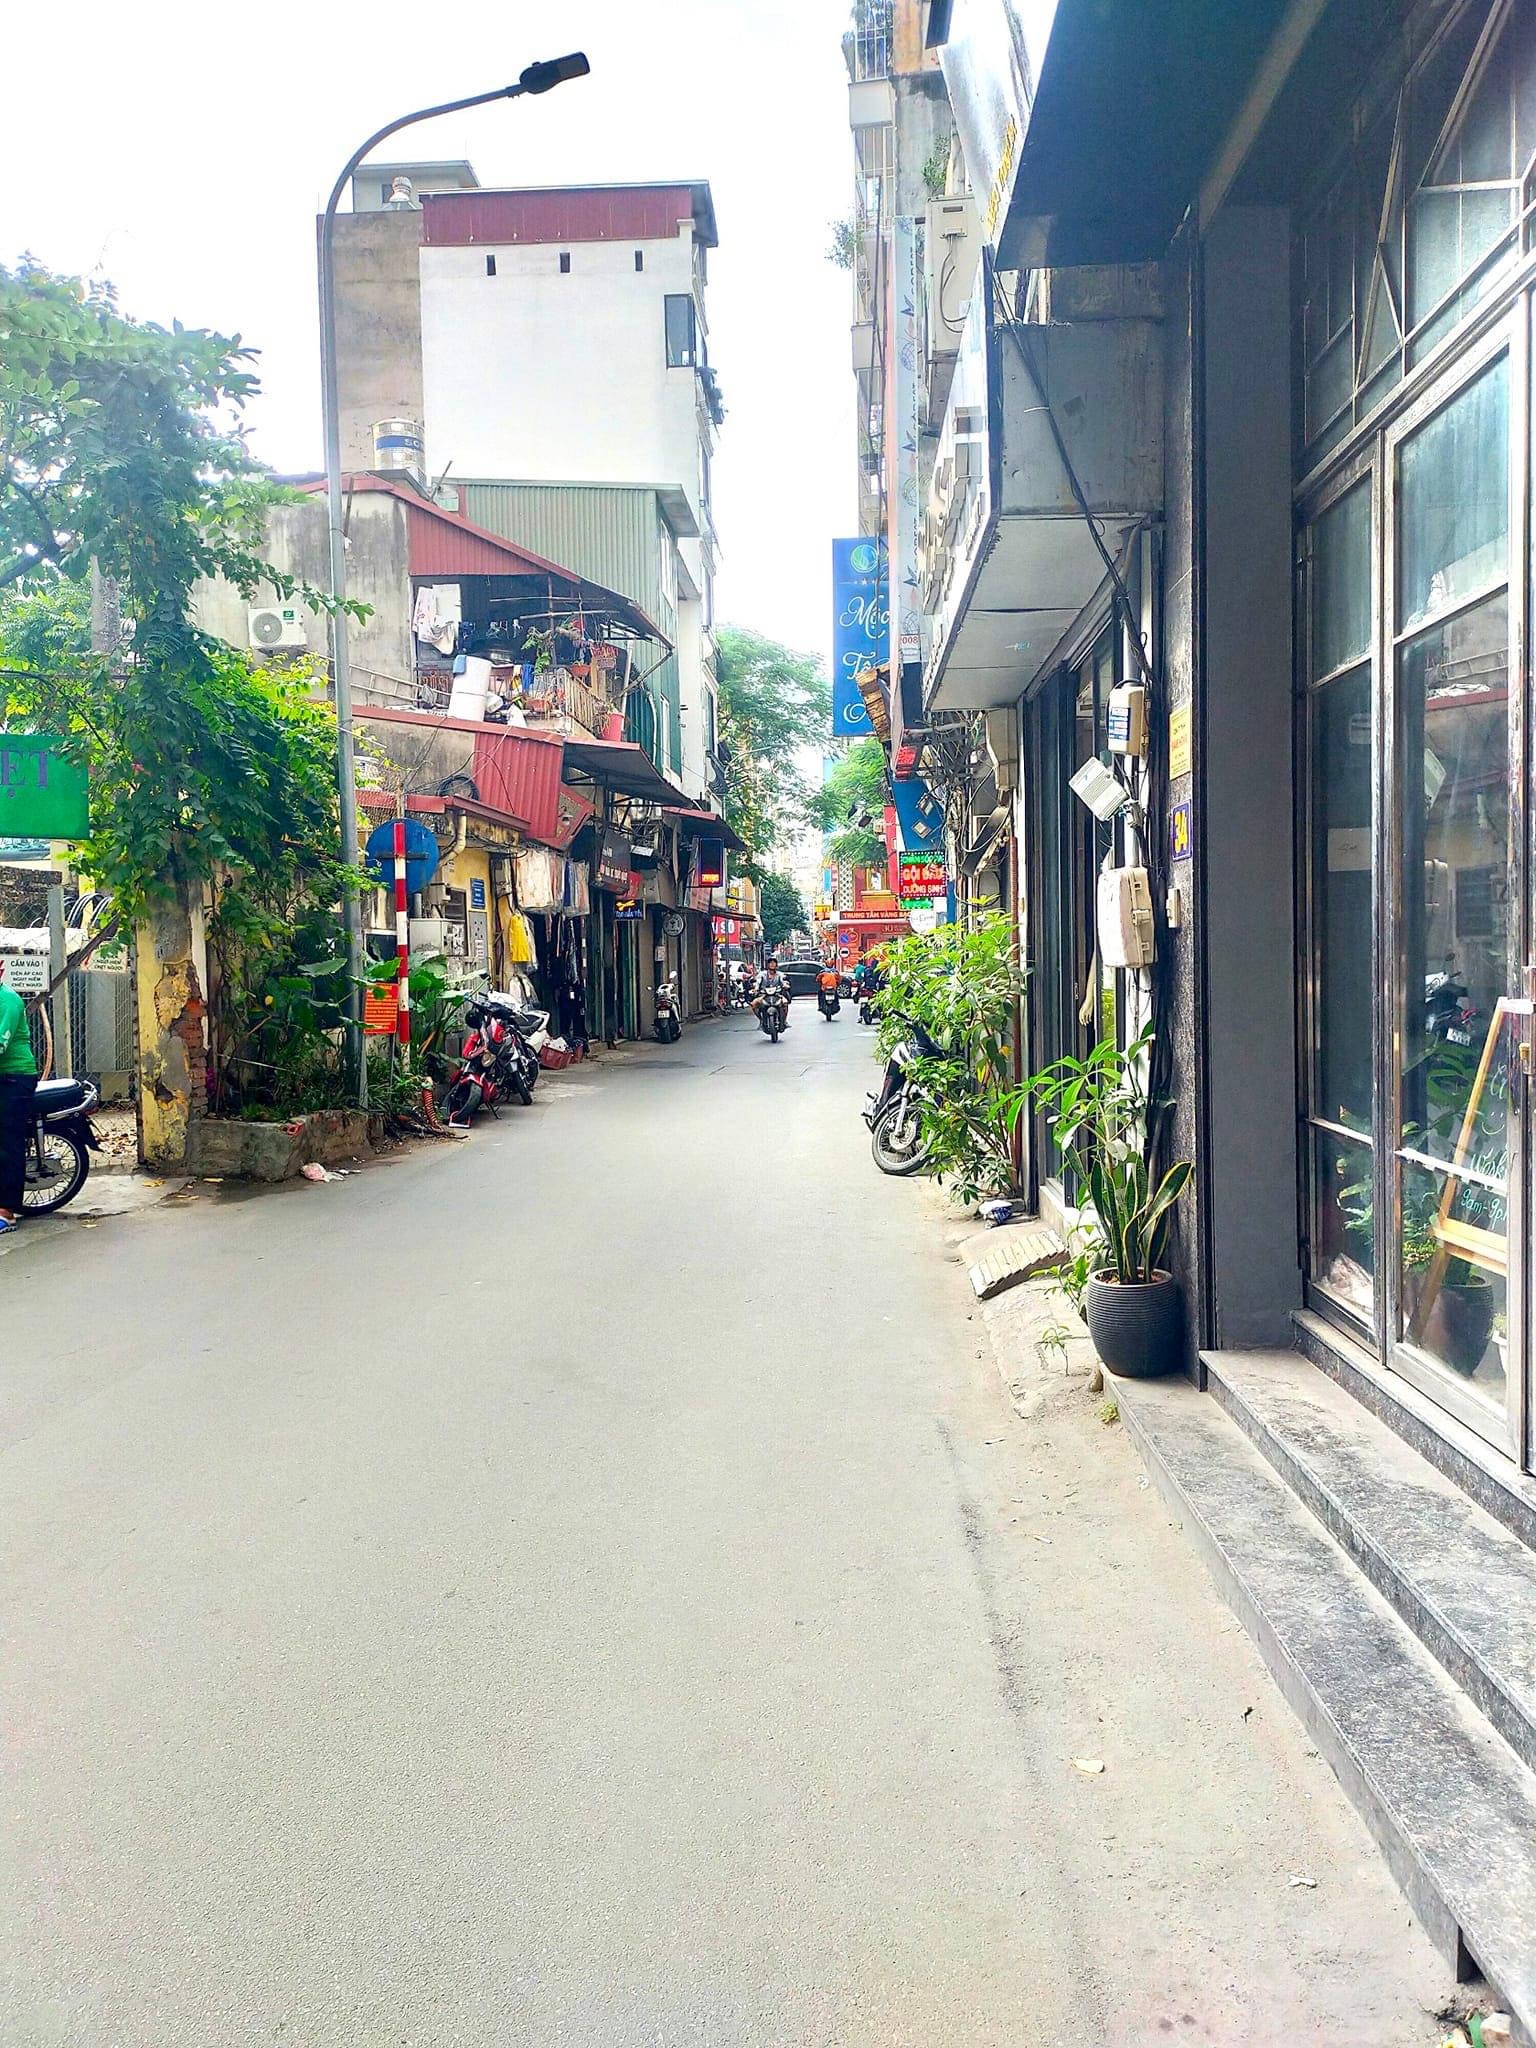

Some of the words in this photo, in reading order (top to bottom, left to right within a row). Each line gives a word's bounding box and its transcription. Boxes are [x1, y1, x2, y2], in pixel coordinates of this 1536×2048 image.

[842, 651, 889, 680] Tâ
[1174, 810, 1188, 854] 34
[903, 865, 921, 883] GỘI
[10, 958, 25, 968] CẤM
[26, 958, 40, 968] VÀO
